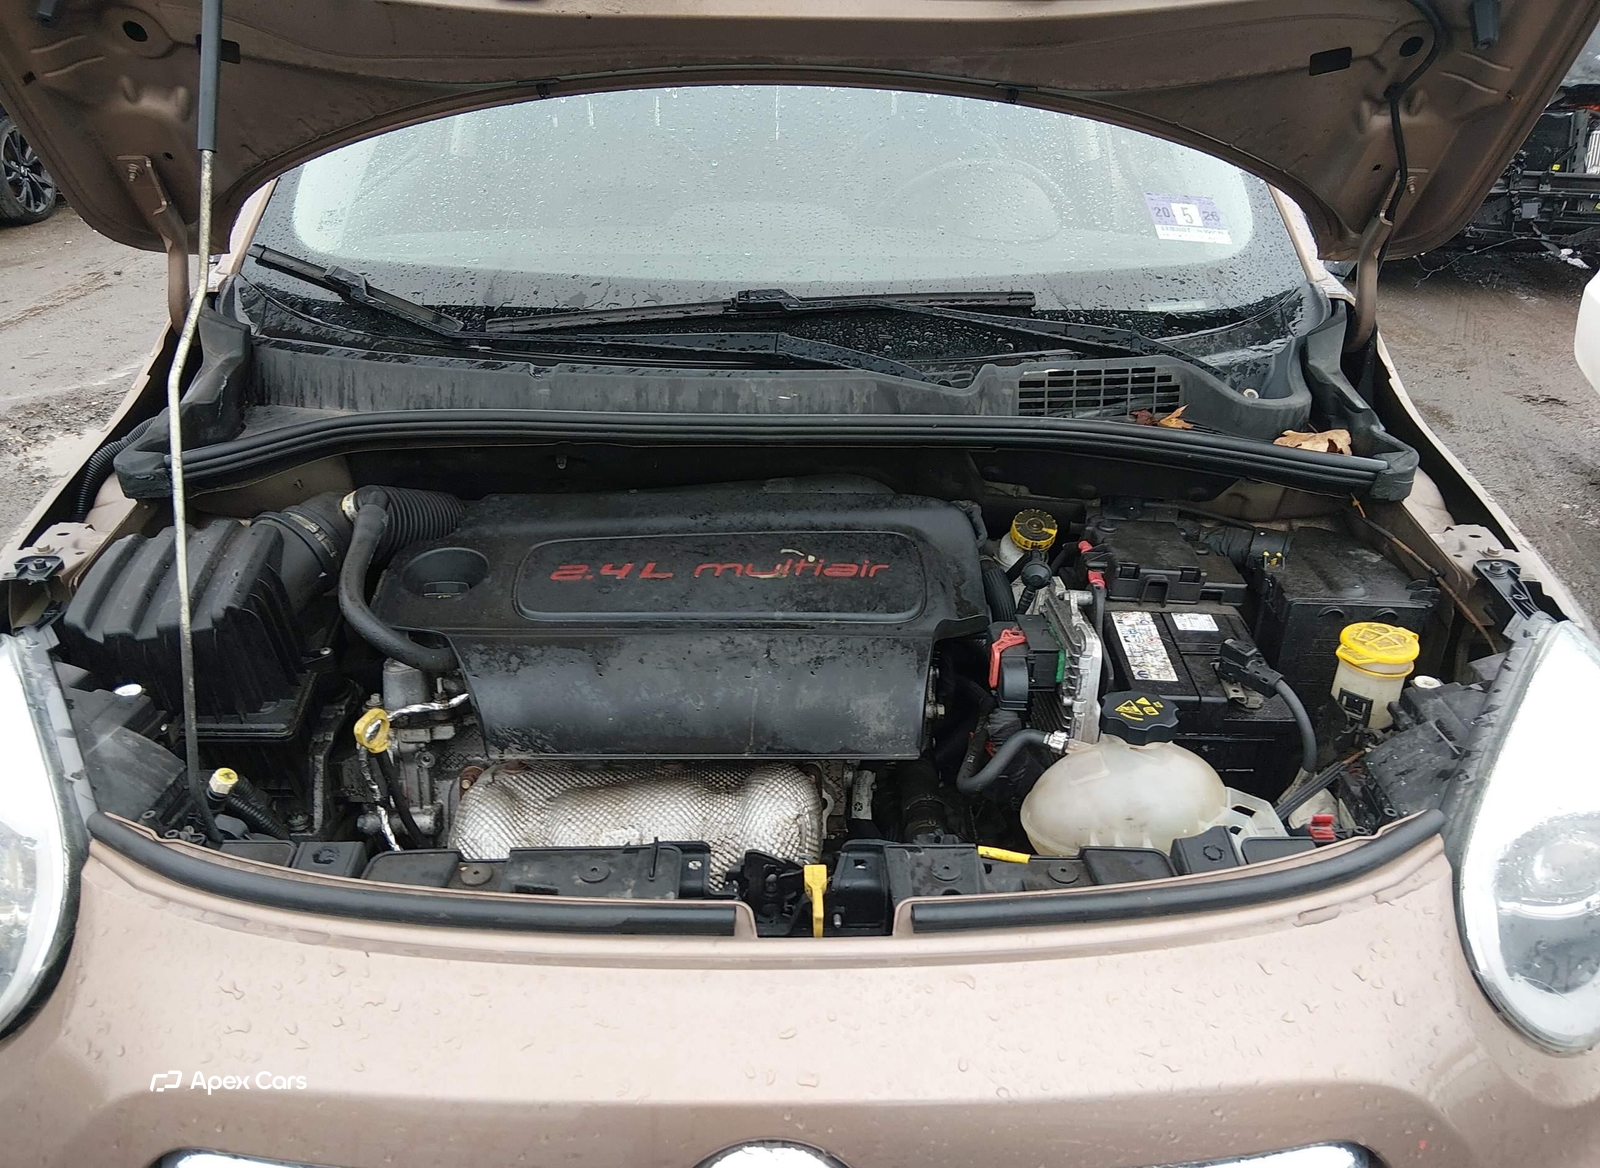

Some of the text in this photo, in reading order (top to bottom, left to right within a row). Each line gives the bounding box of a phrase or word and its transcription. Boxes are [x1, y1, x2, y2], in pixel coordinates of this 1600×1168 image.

[1153, 206, 1171, 218] 20
[1180, 206, 1194, 224] 5
[549, 557, 890, 581] 2.4L multiair
